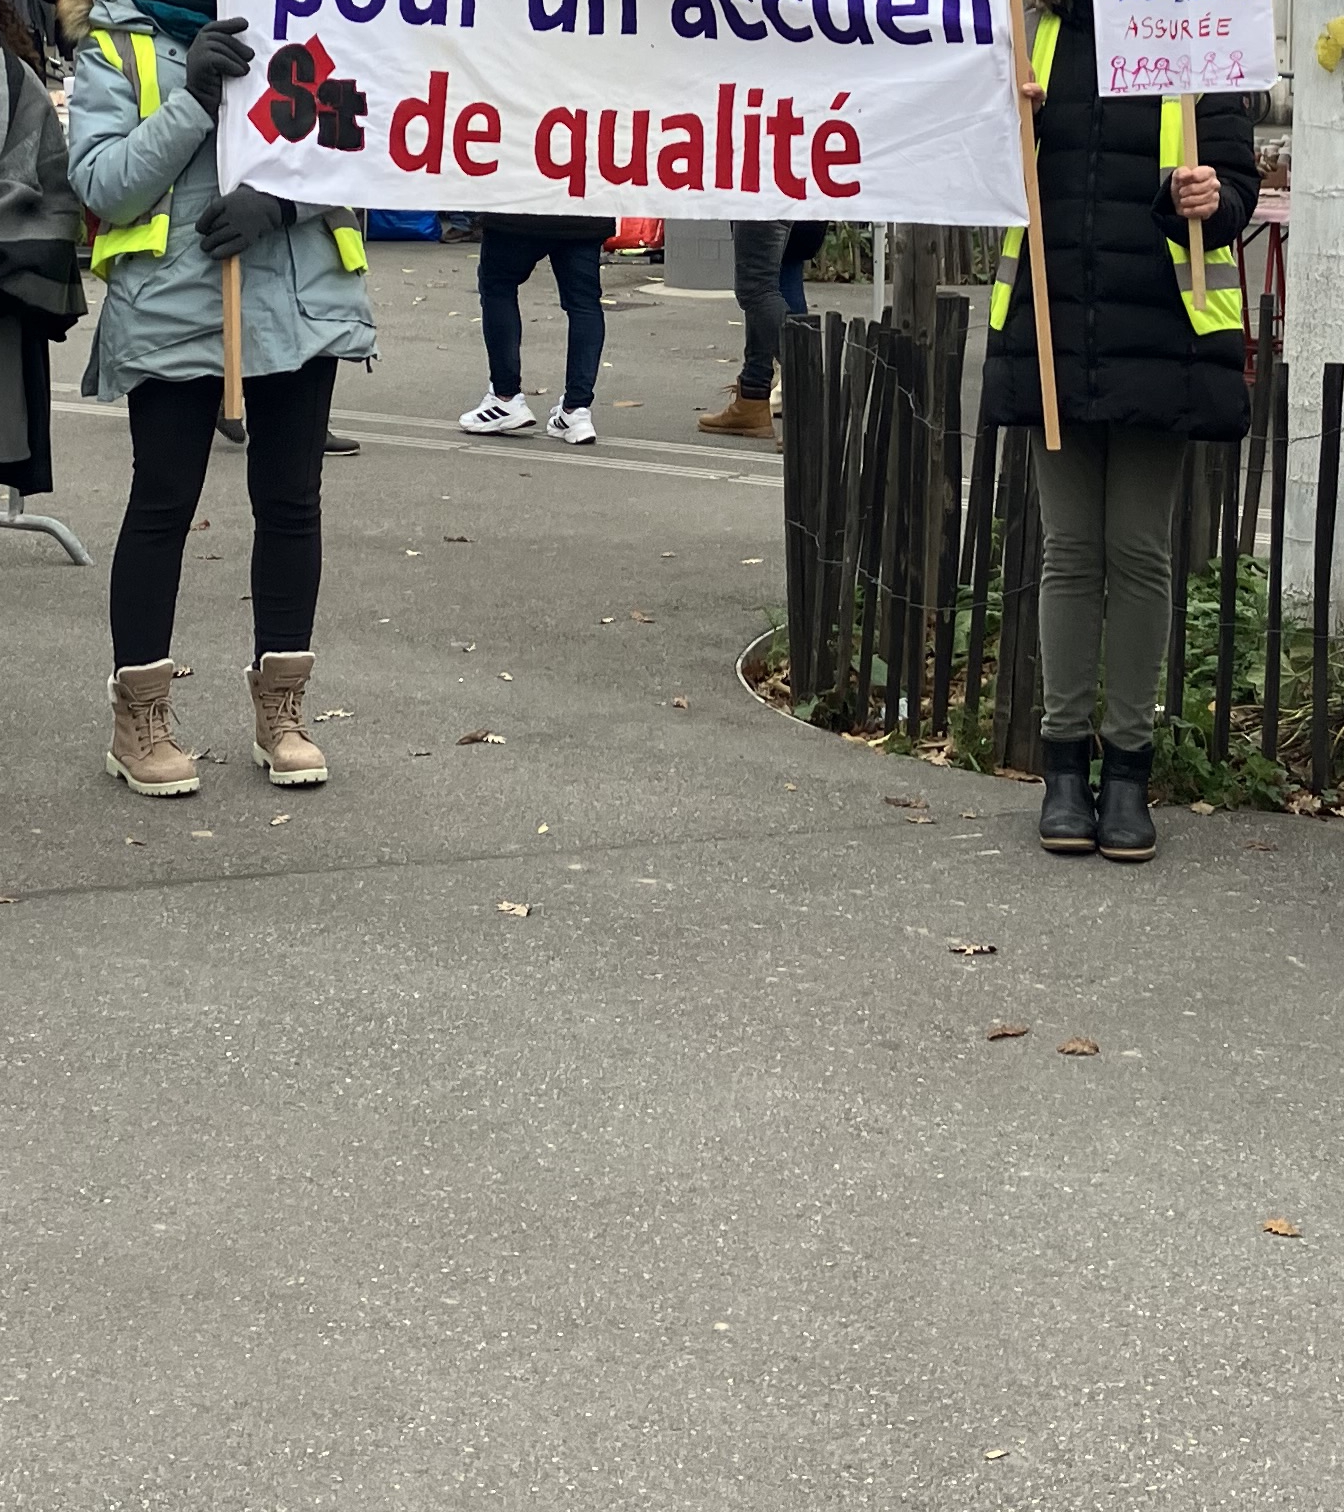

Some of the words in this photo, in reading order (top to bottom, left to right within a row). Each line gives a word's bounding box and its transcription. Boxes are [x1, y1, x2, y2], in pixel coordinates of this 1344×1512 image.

[1124, 12, 1233, 41] ASSURÉE
[388, 70, 502, 179] de
[534, 83, 862, 202] qualité
